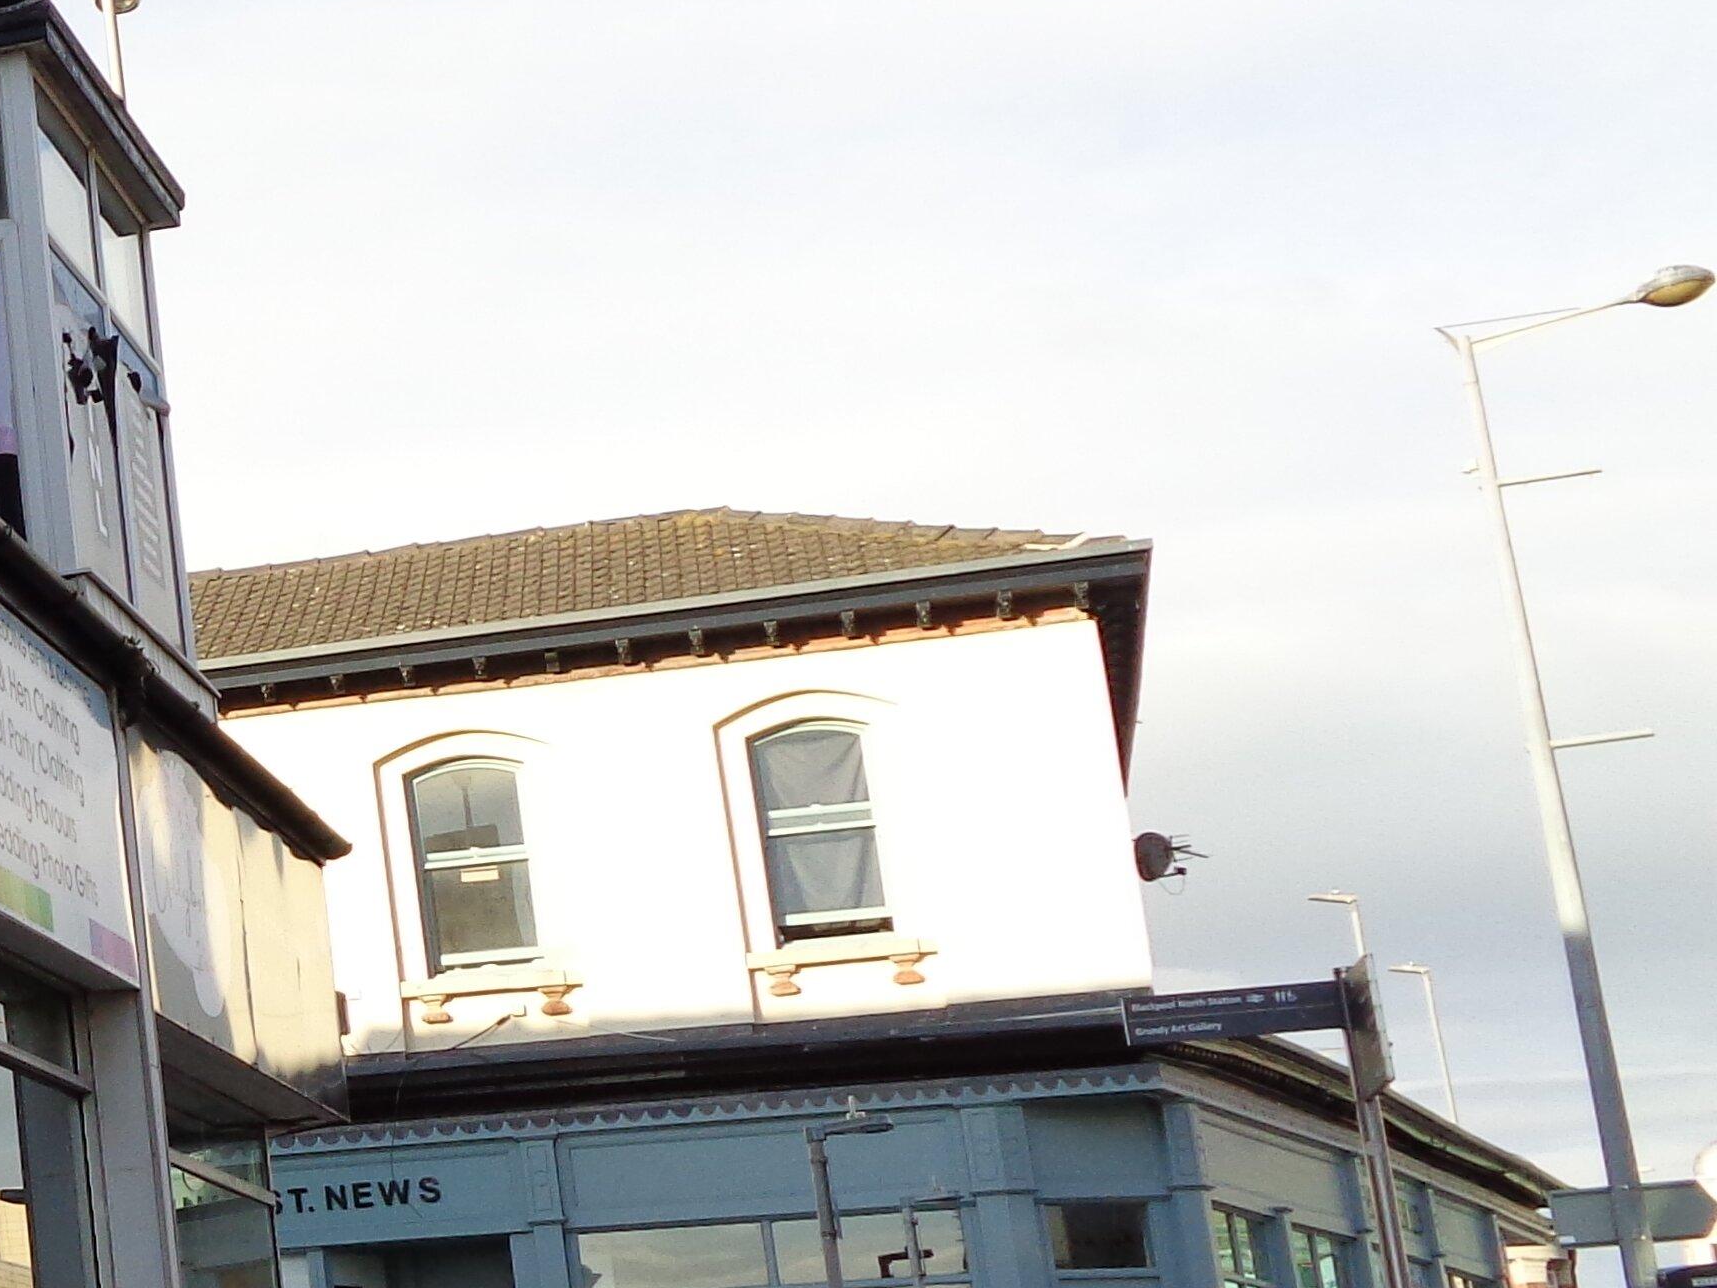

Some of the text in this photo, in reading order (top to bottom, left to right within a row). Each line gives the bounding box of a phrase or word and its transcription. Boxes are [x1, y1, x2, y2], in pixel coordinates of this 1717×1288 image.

[7, 665, 32, 712] Hen
[33, 687, 80, 756] Clothing
[38, 740, 85, 808] Clothing
[32, 786, 77, 844] Favours
[324, 1177, 442, 1212] NEWS
